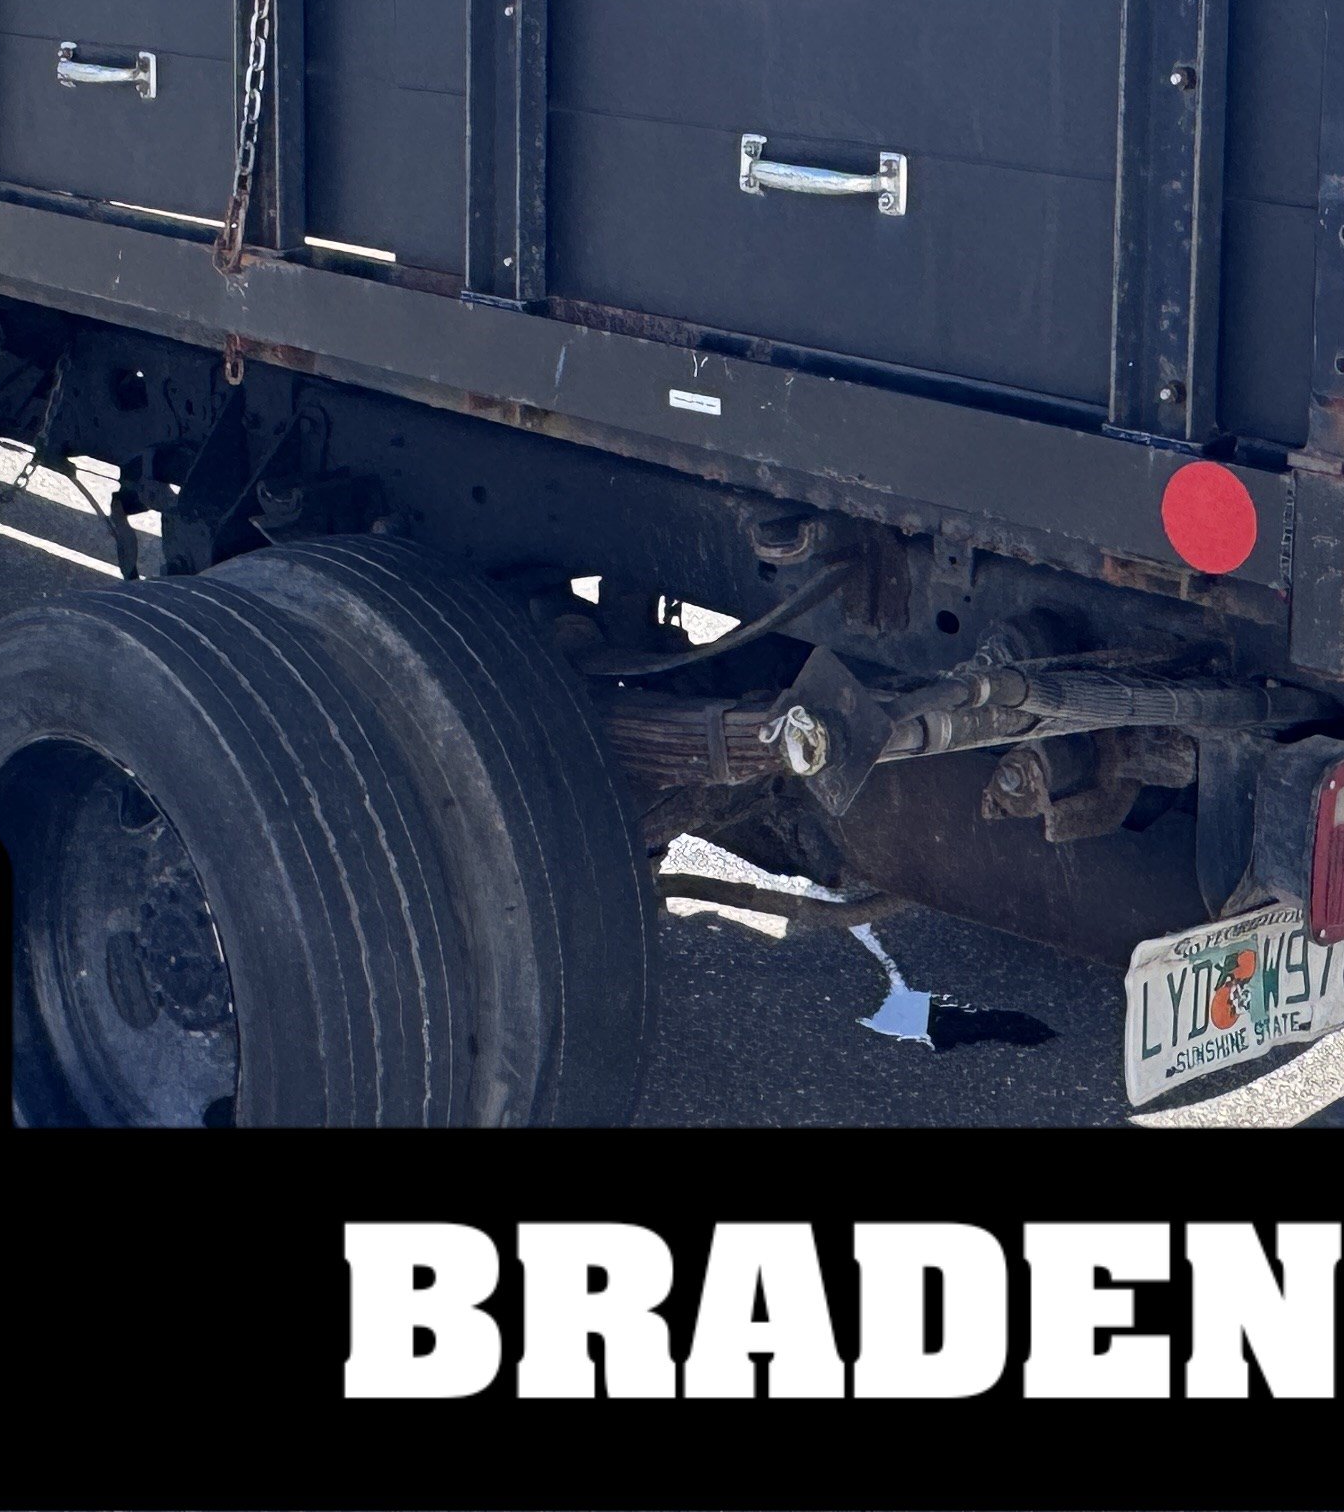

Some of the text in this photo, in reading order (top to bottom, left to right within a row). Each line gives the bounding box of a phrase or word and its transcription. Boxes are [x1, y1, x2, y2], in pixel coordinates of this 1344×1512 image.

[1141, 959, 1213, 1061] LYD
[1174, 1011, 1301, 1074] SUNSHINE STATE
